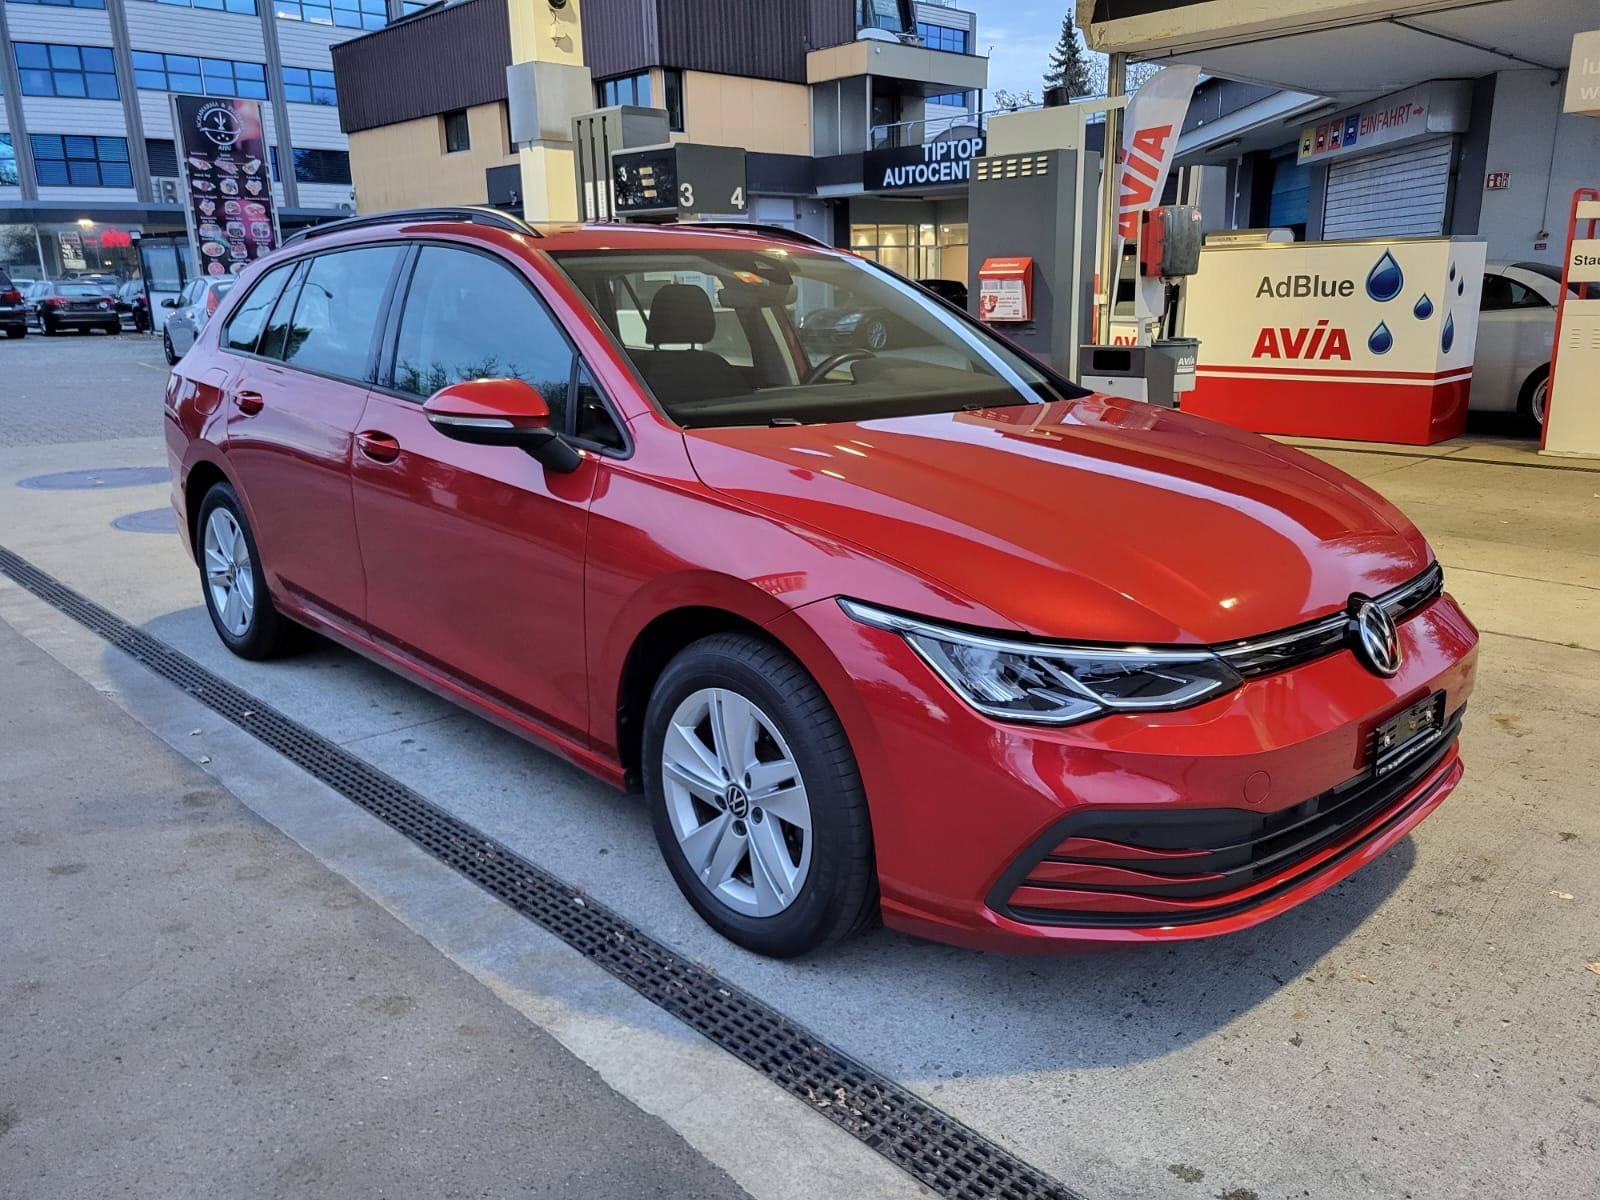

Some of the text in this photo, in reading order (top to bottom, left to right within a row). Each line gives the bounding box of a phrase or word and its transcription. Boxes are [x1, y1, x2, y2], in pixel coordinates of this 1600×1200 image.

[1360, 103, 1412, 136] EINFAHRT
[921, 138, 983, 162] TIPTOP
[679, 183, 745, 210] 3 4
[1255, 274, 1355, 299] AdBlue
